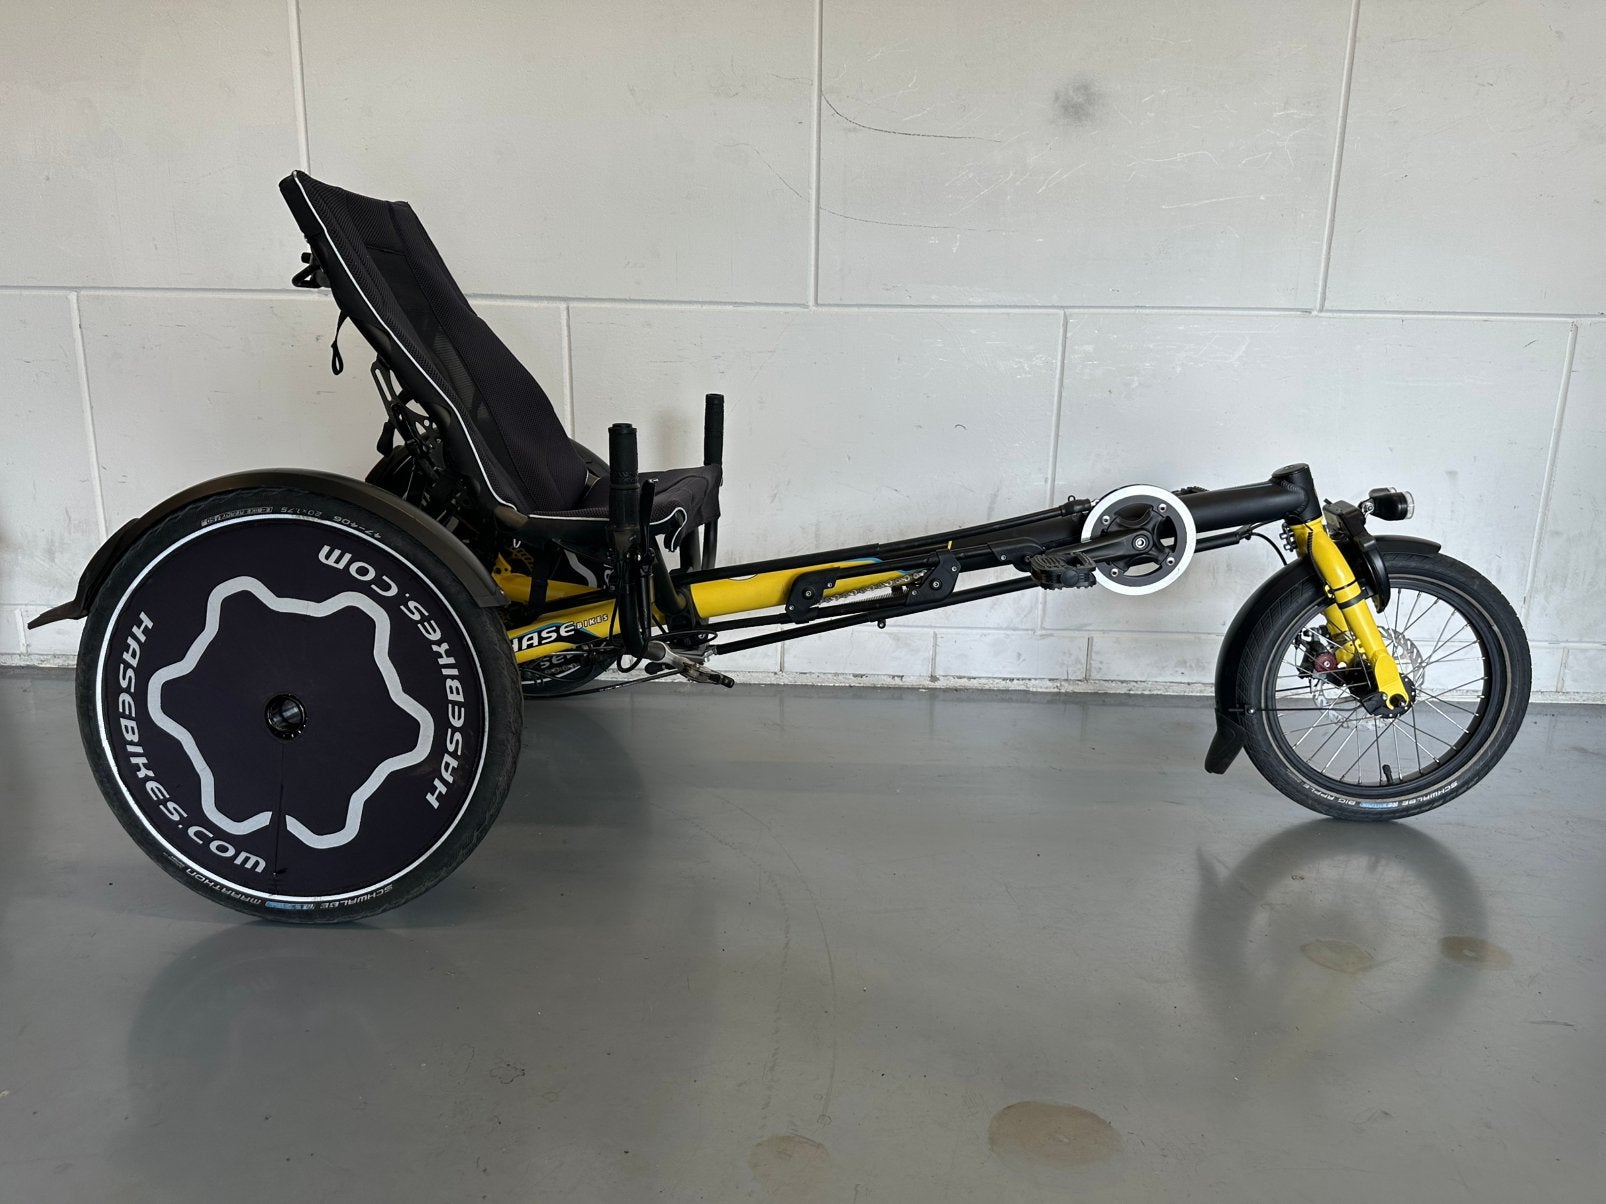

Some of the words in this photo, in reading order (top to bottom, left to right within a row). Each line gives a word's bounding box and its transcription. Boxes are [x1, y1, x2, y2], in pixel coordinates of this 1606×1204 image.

[332, 515, 383, 539] 47-406
[575, 613, 609, 630] BIKES
[1302, 783, 1335, 801] APPLE
[1337, 798, 1356, 806] BIG
[1401, 780, 1458, 806] SCHWALBE
[185, 867, 262, 906] MARATHON
[319, 883, 393, 910] SCHWALBE
